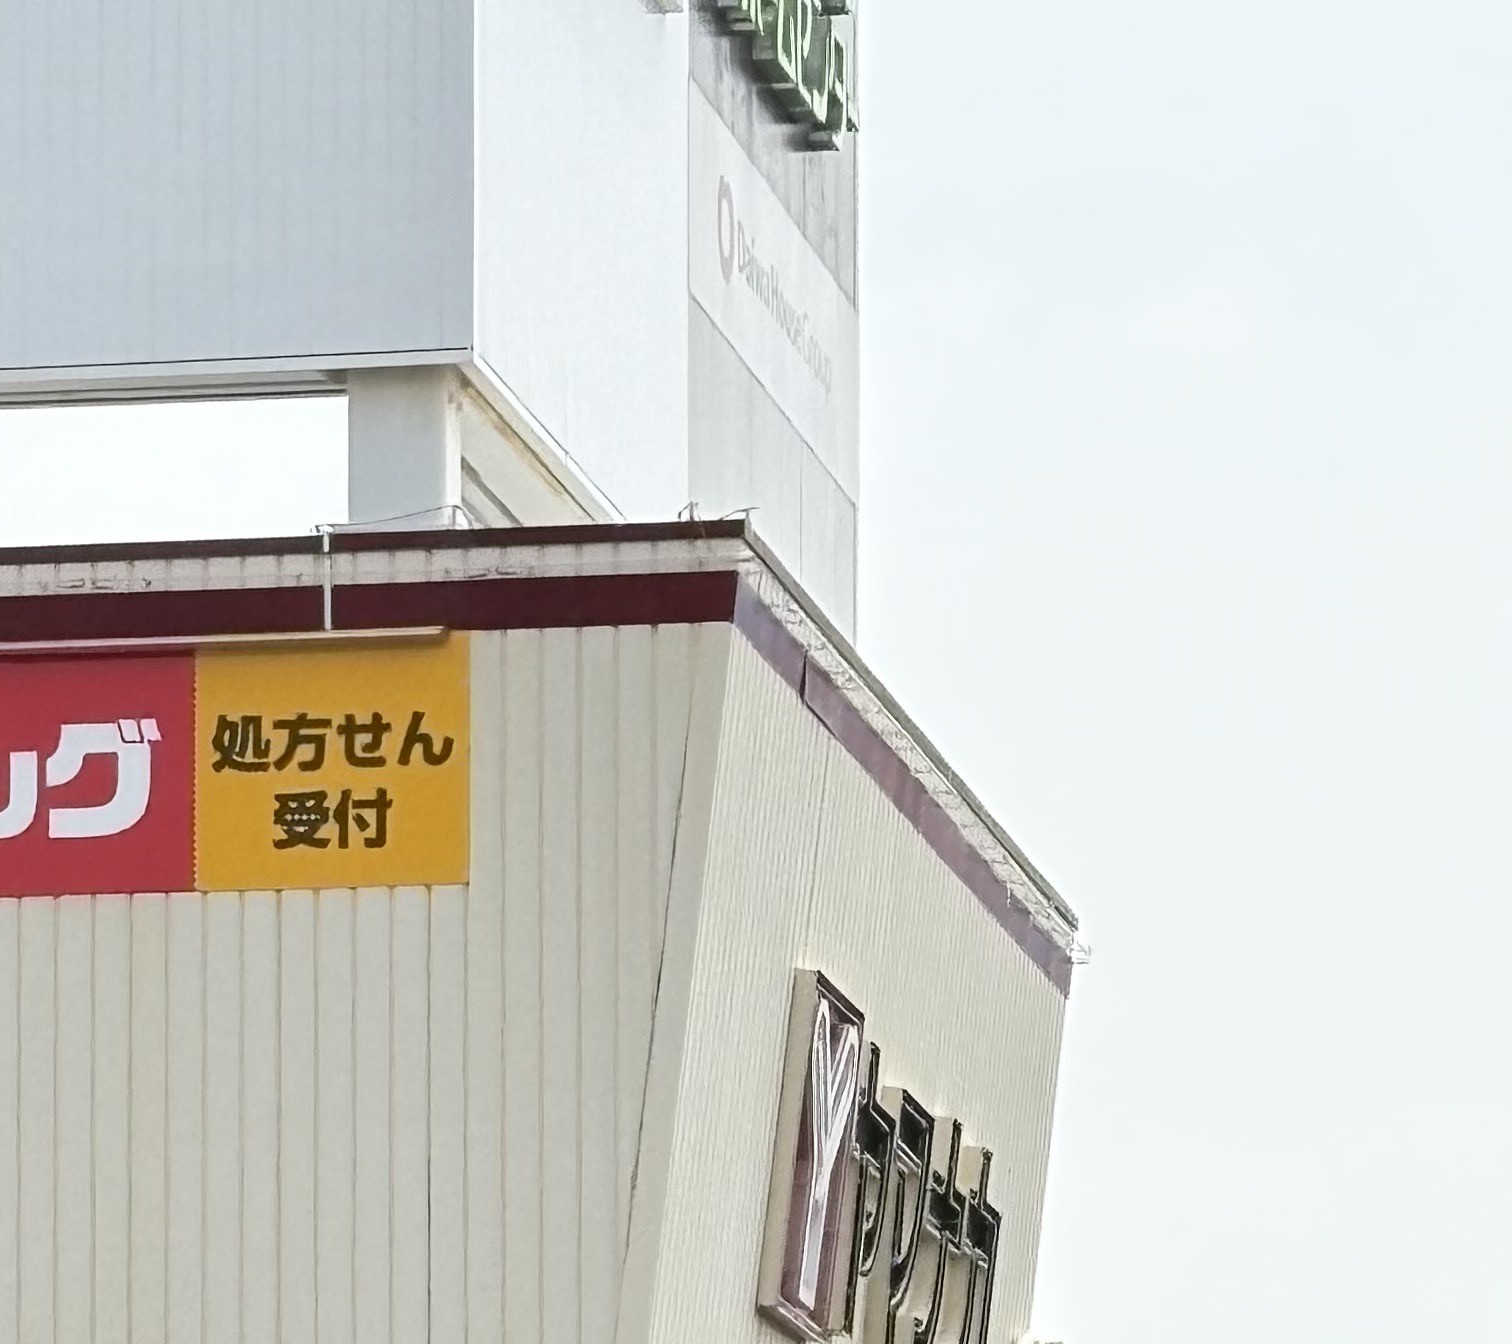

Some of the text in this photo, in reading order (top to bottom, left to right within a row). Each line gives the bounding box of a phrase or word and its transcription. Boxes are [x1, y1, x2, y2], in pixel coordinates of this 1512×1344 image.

[211, 710, 455, 774] 処方せん
[272, 786, 395, 851] 受付
